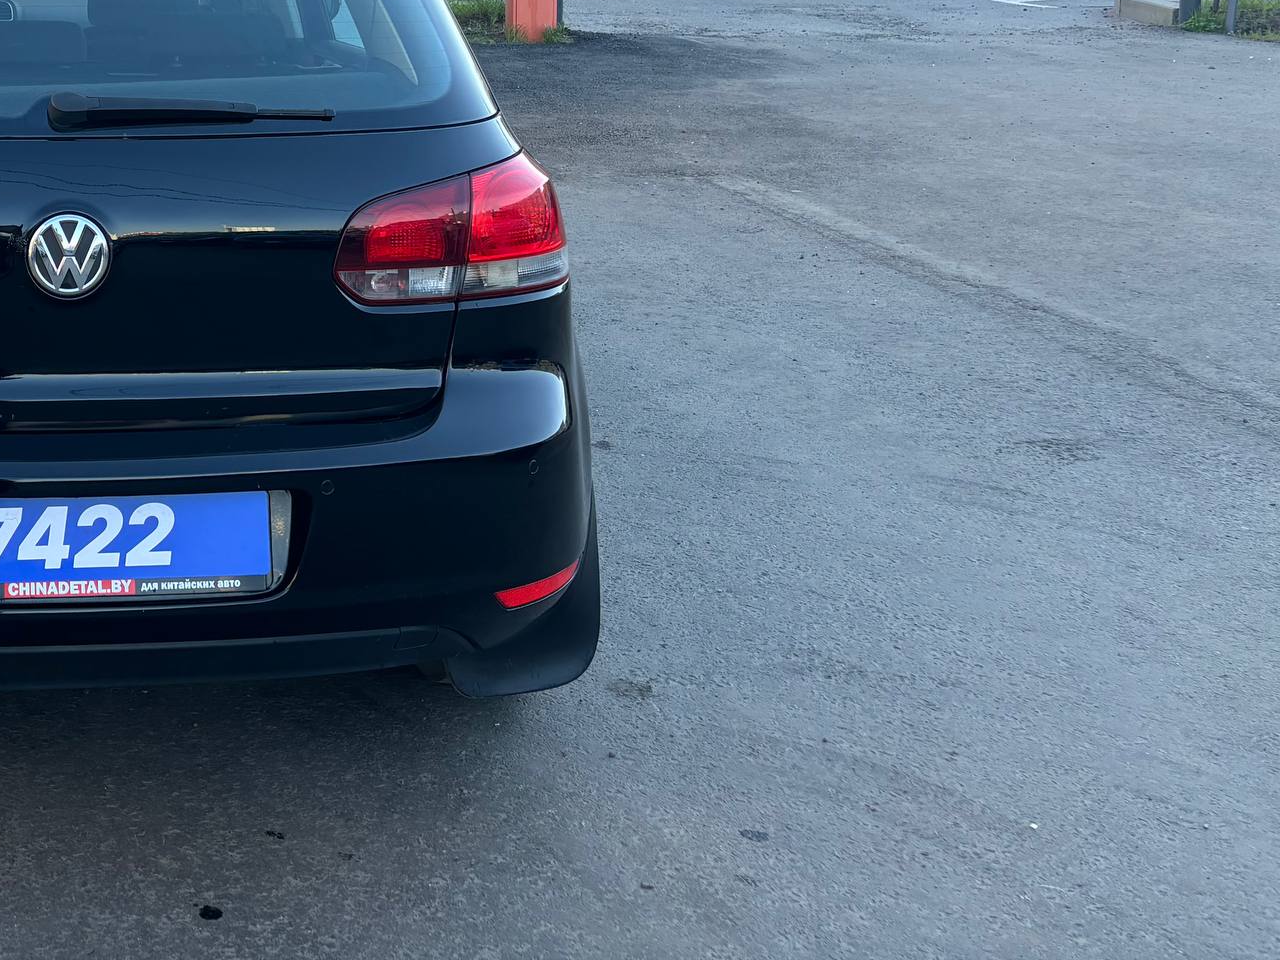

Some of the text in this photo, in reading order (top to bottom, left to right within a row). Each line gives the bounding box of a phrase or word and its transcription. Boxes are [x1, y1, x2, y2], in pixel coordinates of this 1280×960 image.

[8, 579, 132, 596] CHINADETAL.BY
[141, 582, 158, 591] для
[161, 579, 215, 591] китайских
[217, 579, 241, 588] авто
